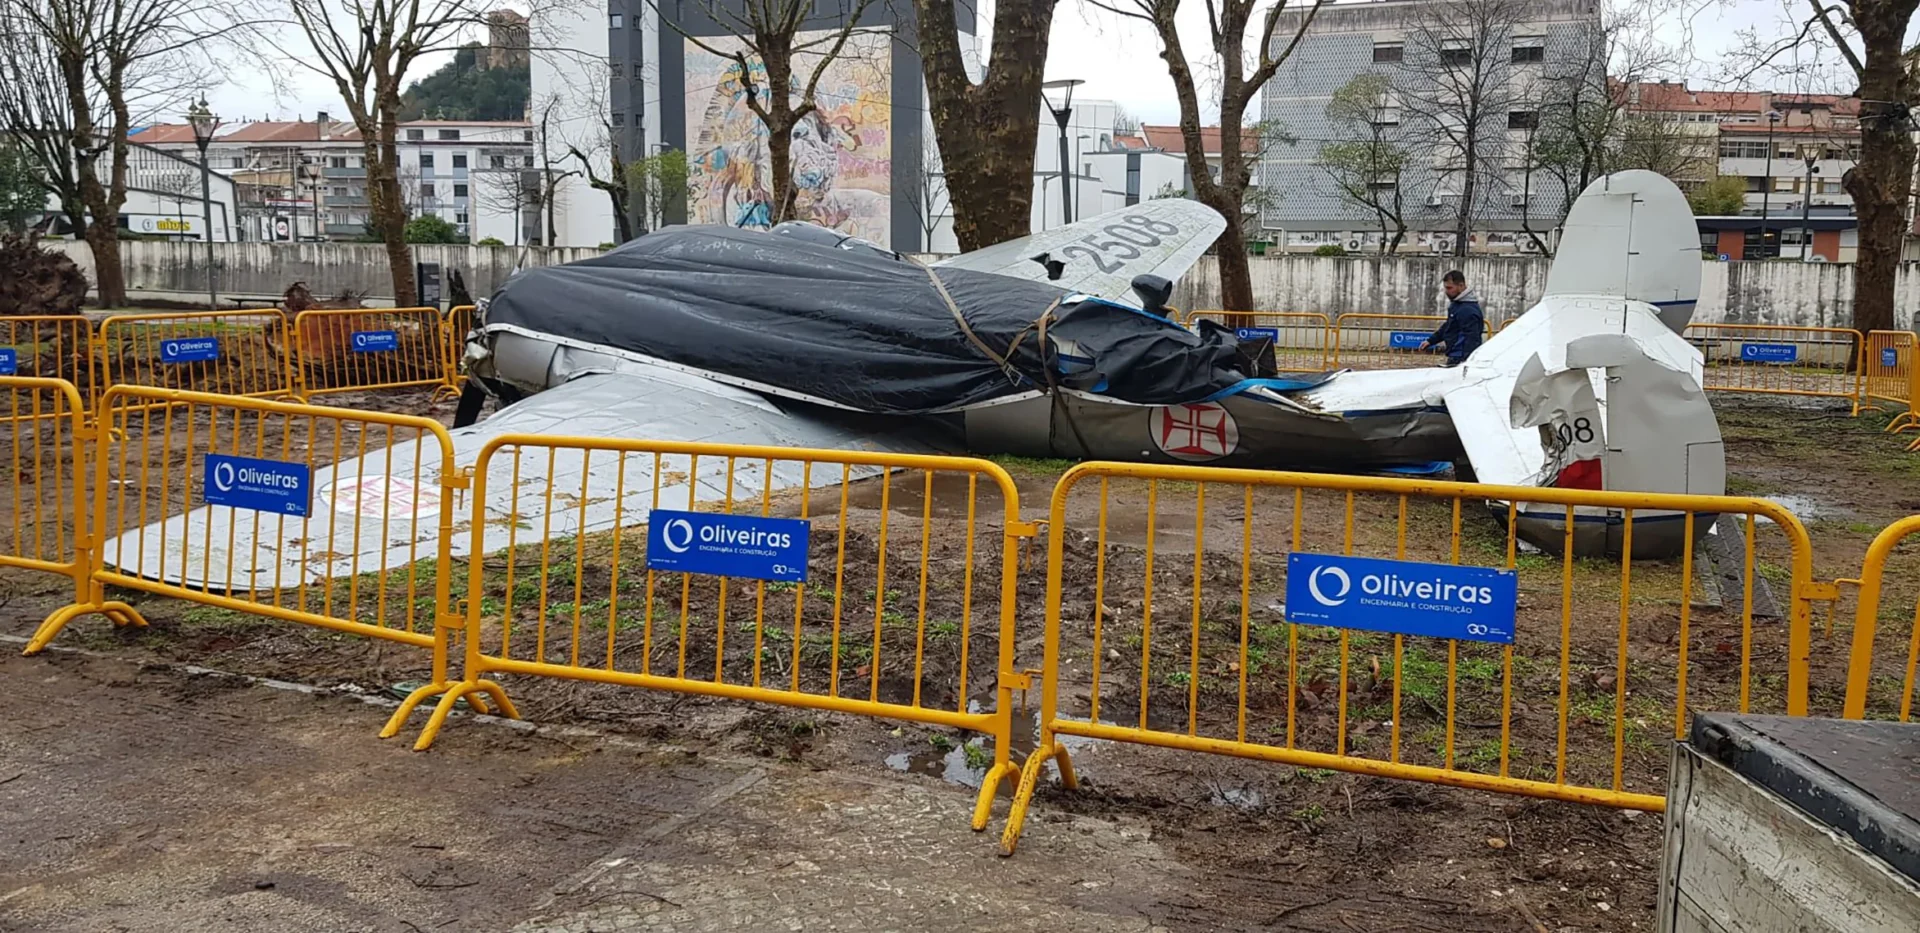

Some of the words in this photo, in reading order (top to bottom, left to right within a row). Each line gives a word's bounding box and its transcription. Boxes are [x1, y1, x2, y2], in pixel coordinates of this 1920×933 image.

[1063, 215, 1179, 274] 2508
[180, 342, 212, 350] Oliveiras
[238, 467, 299, 489] Oliveiras
[700, 525, 791, 548] Oliveiras
[699, 545, 733, 553] ENGENHARIA
[739, 548, 777, 557] CONSTRUÇÃO
[1361, 574, 1493, 604] Oliveiras
[1360, 598, 1409, 608] ENGENHARIA
[1418, 603, 1473, 614] CONSTRUÇÃO
